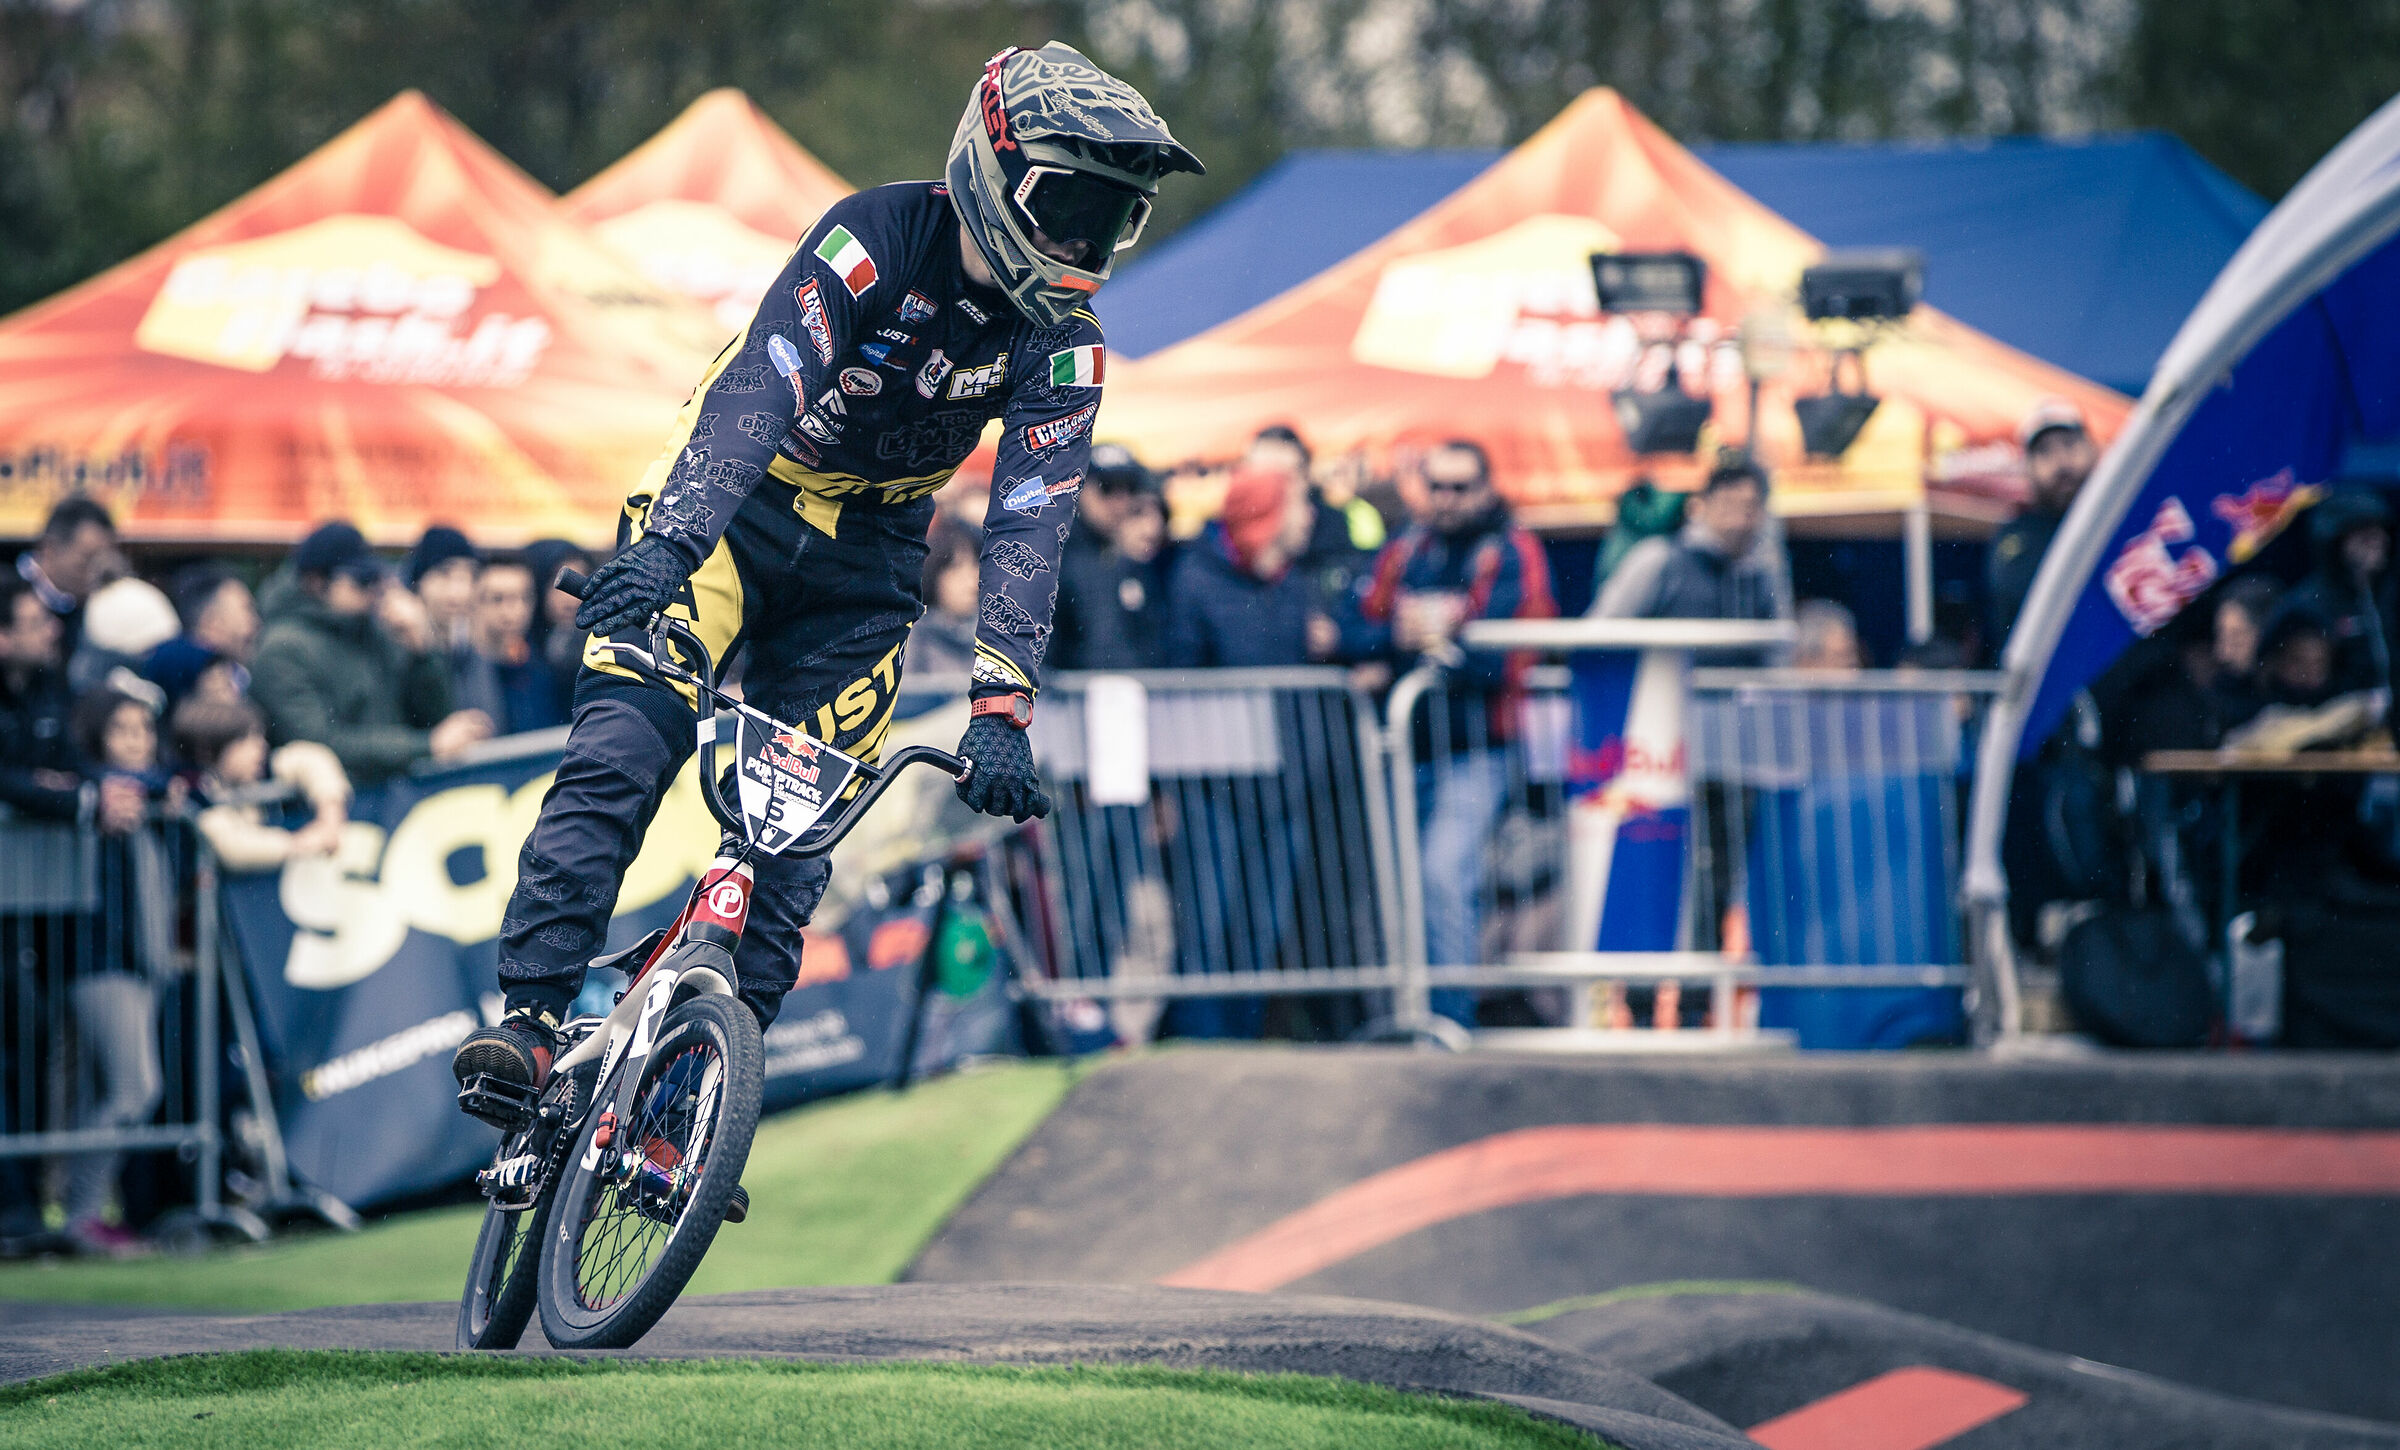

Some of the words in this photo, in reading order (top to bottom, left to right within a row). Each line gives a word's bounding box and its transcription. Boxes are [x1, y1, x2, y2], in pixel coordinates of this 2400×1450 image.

[770, 336, 797, 372] Digital
[861, 344, 887, 360] Digital
[812, 400, 845, 432] ERRARI
[709, 465, 745, 483] BMX
[996, 541, 1029, 563] BMX
[1018, 544, 1043, 566] Racing
[1000, 557, 1022, 577] Park
[982, 595, 1013, 620] BMX
[1002, 598, 1030, 623] Racing
[987, 614, 1009, 634] Park
